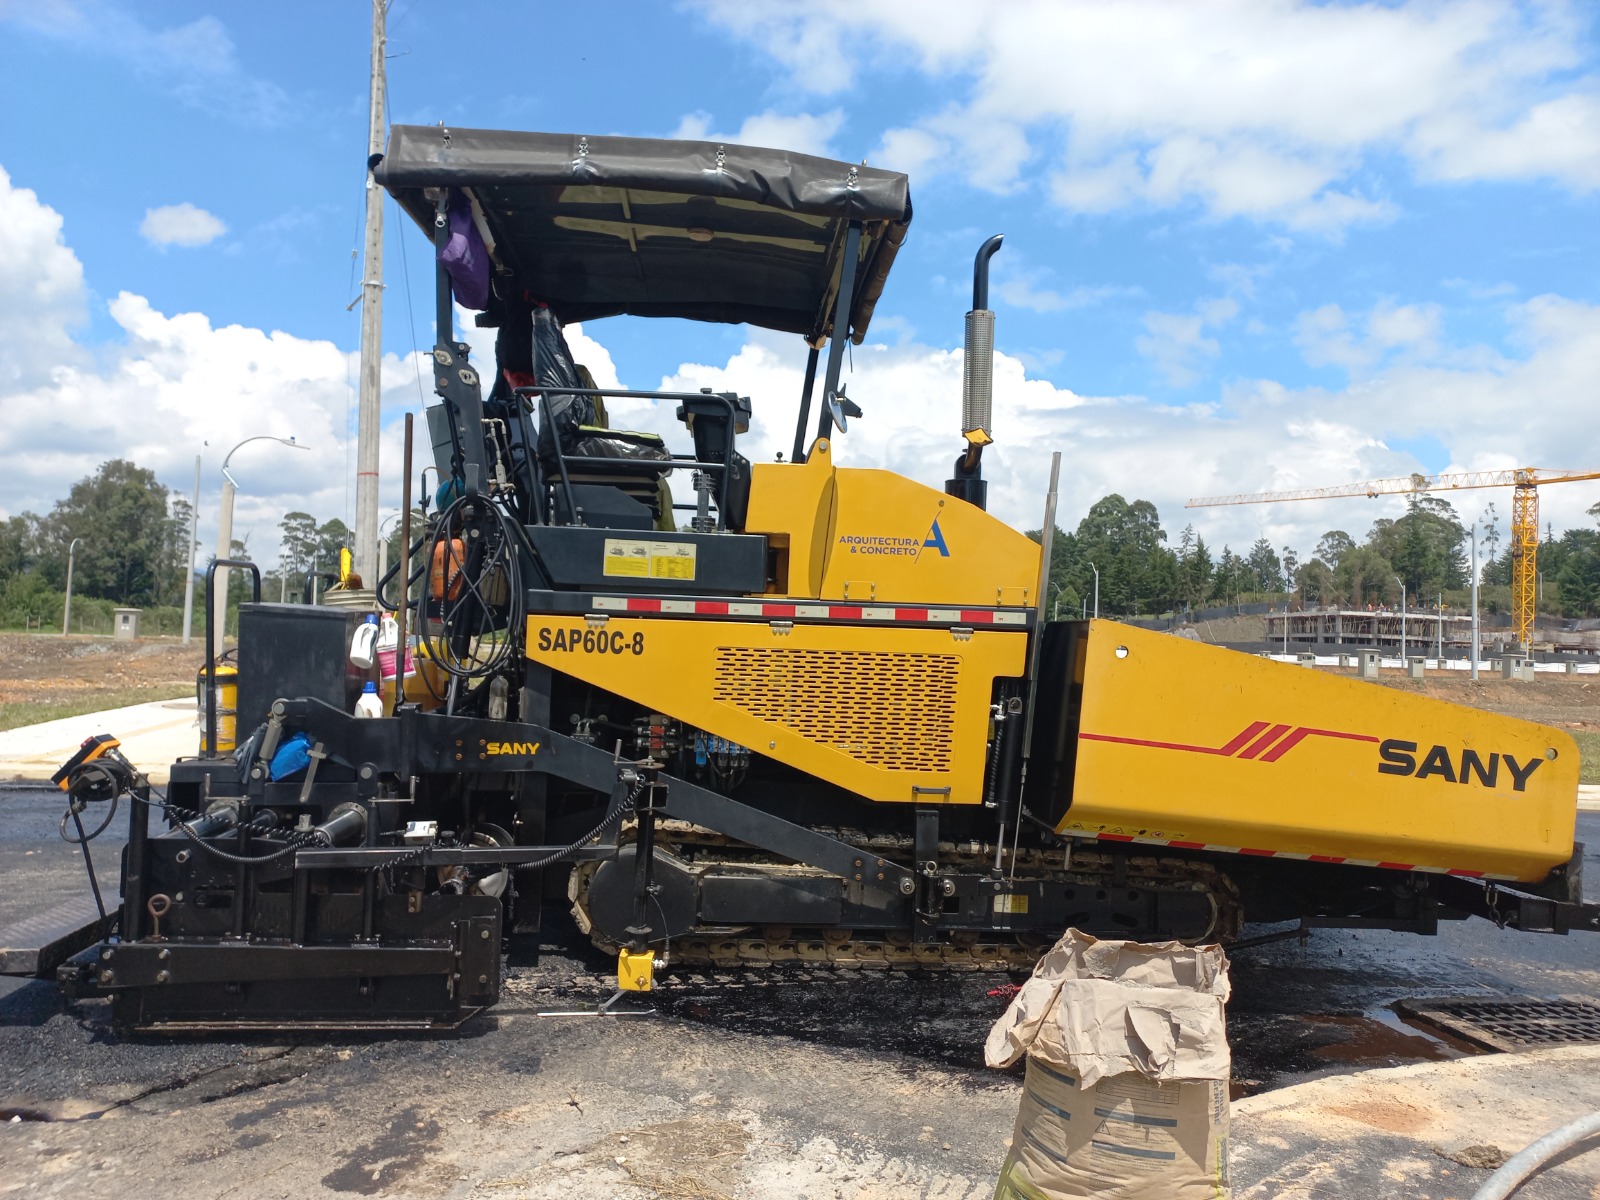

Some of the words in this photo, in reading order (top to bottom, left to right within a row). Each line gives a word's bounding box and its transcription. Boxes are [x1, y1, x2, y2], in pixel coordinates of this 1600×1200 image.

[839, 535, 920, 547] ARQUITECTURA
[850, 545, 858, 554] &
[860, 546, 917, 556] CONCRETO
[537, 627, 645, 656] SAP60C-8
[486, 742, 540, 755] SANY
[1377, 738, 1545, 793] SANY
